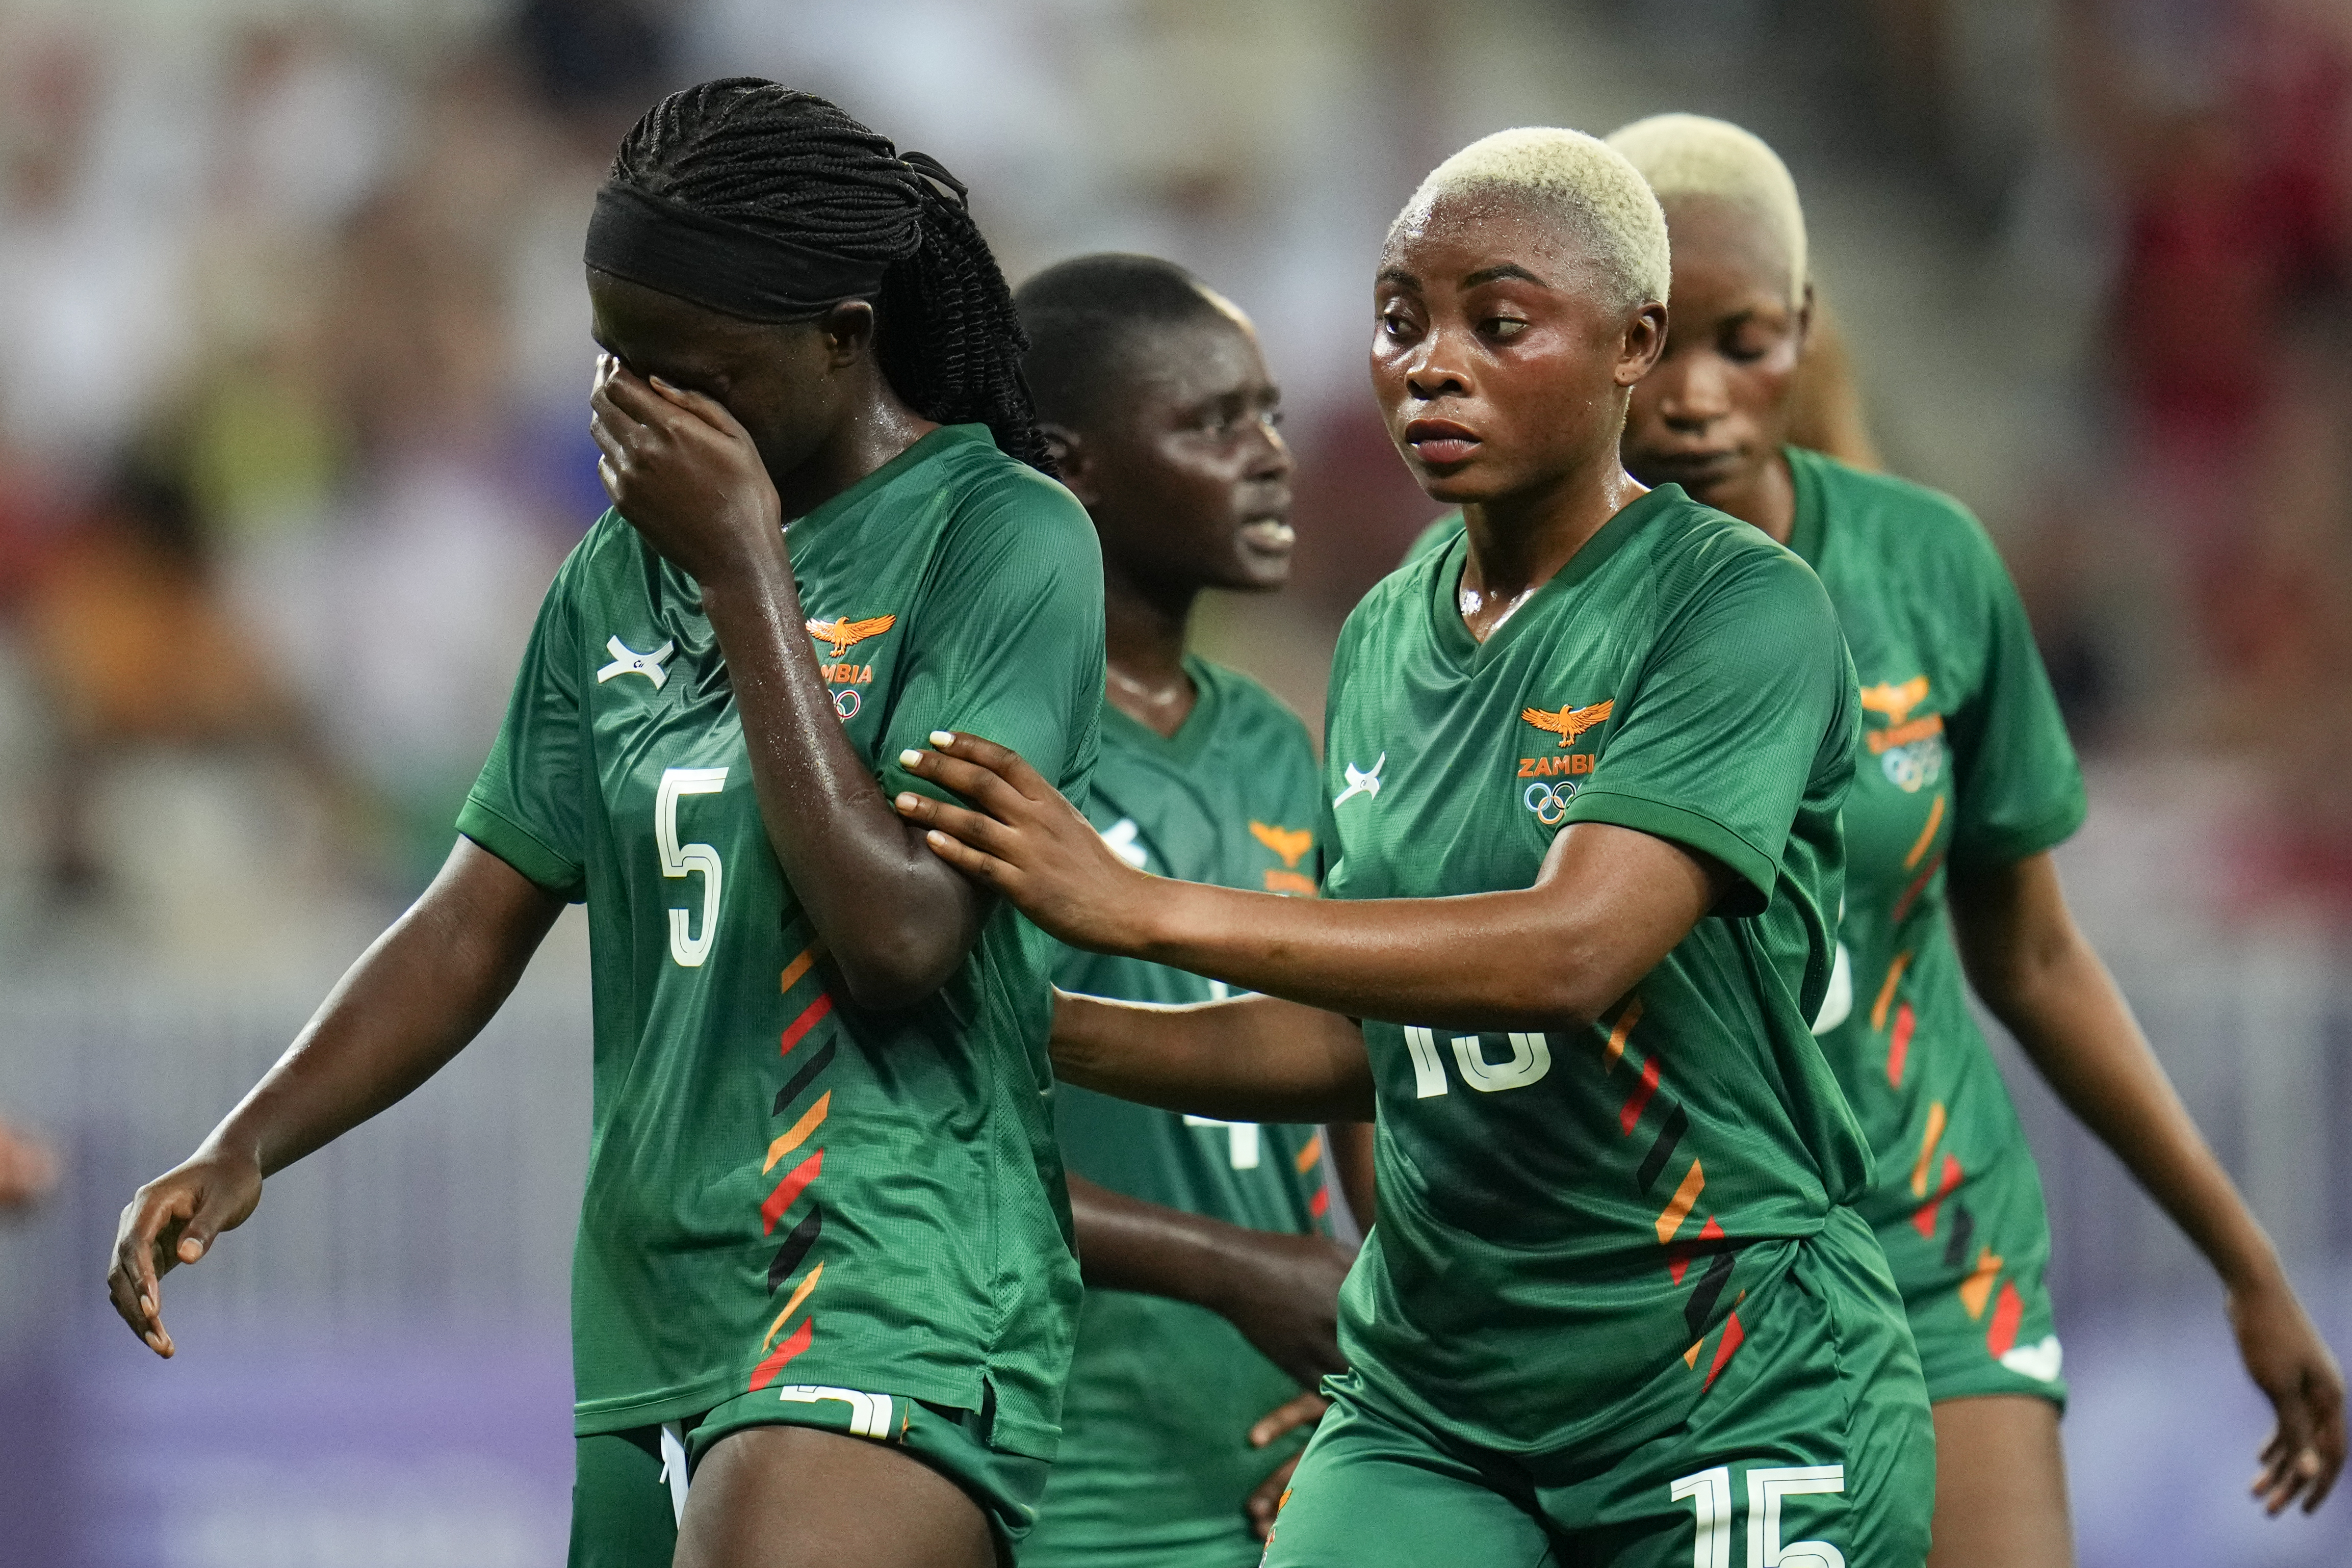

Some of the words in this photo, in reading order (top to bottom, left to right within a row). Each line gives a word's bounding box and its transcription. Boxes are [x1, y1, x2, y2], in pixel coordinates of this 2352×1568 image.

[820, 664, 872, 684] MBIA
[1517, 753, 1595, 777] ZAMBI
[655, 767, 729, 967] 5
